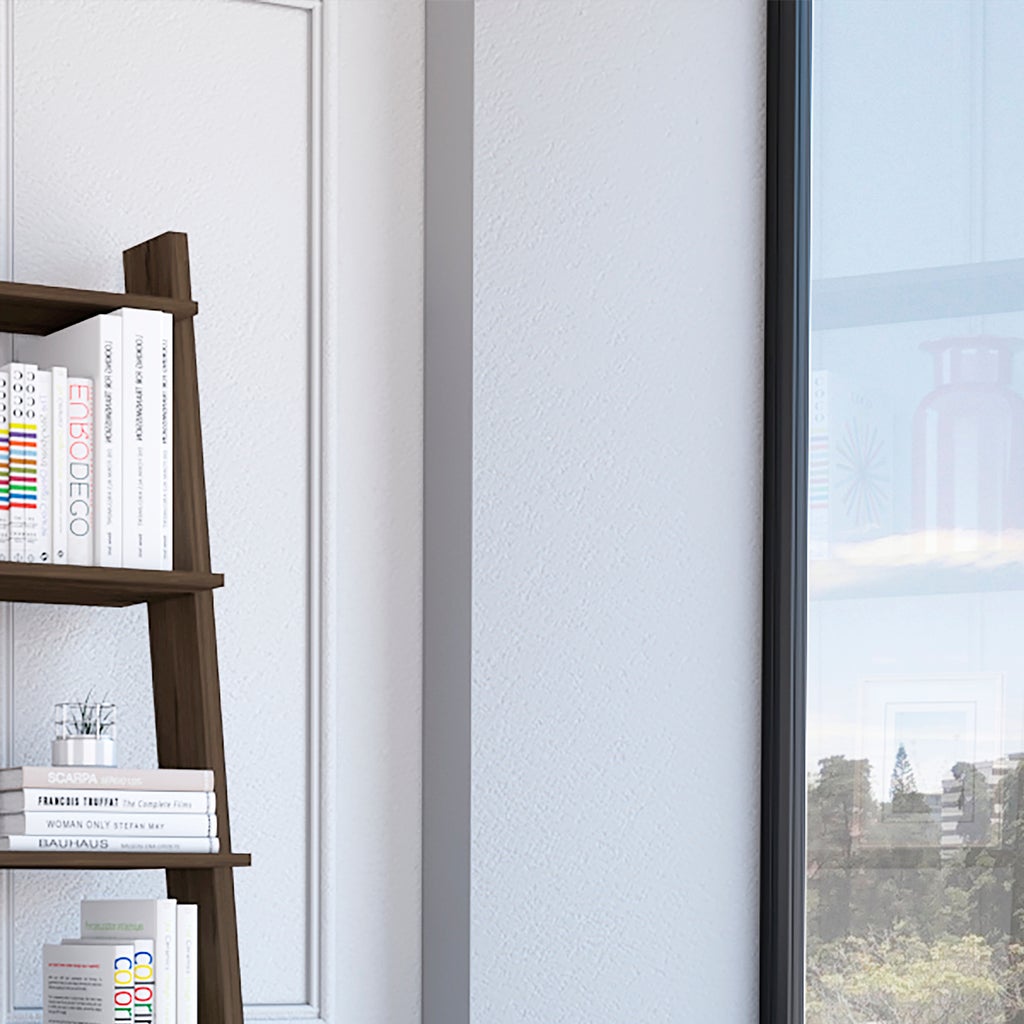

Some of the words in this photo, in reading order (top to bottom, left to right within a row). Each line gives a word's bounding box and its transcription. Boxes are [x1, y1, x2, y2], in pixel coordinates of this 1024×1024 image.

[47, 771, 98, 785] SCARPA
[83, 797, 119, 807] TRUFFAT
[47, 820, 83, 829] WOMAN
[86, 820, 110, 830] ONLY
[113, 822, 145, 830] STEFAN
[38, 838, 109, 849] BAUHAUS
